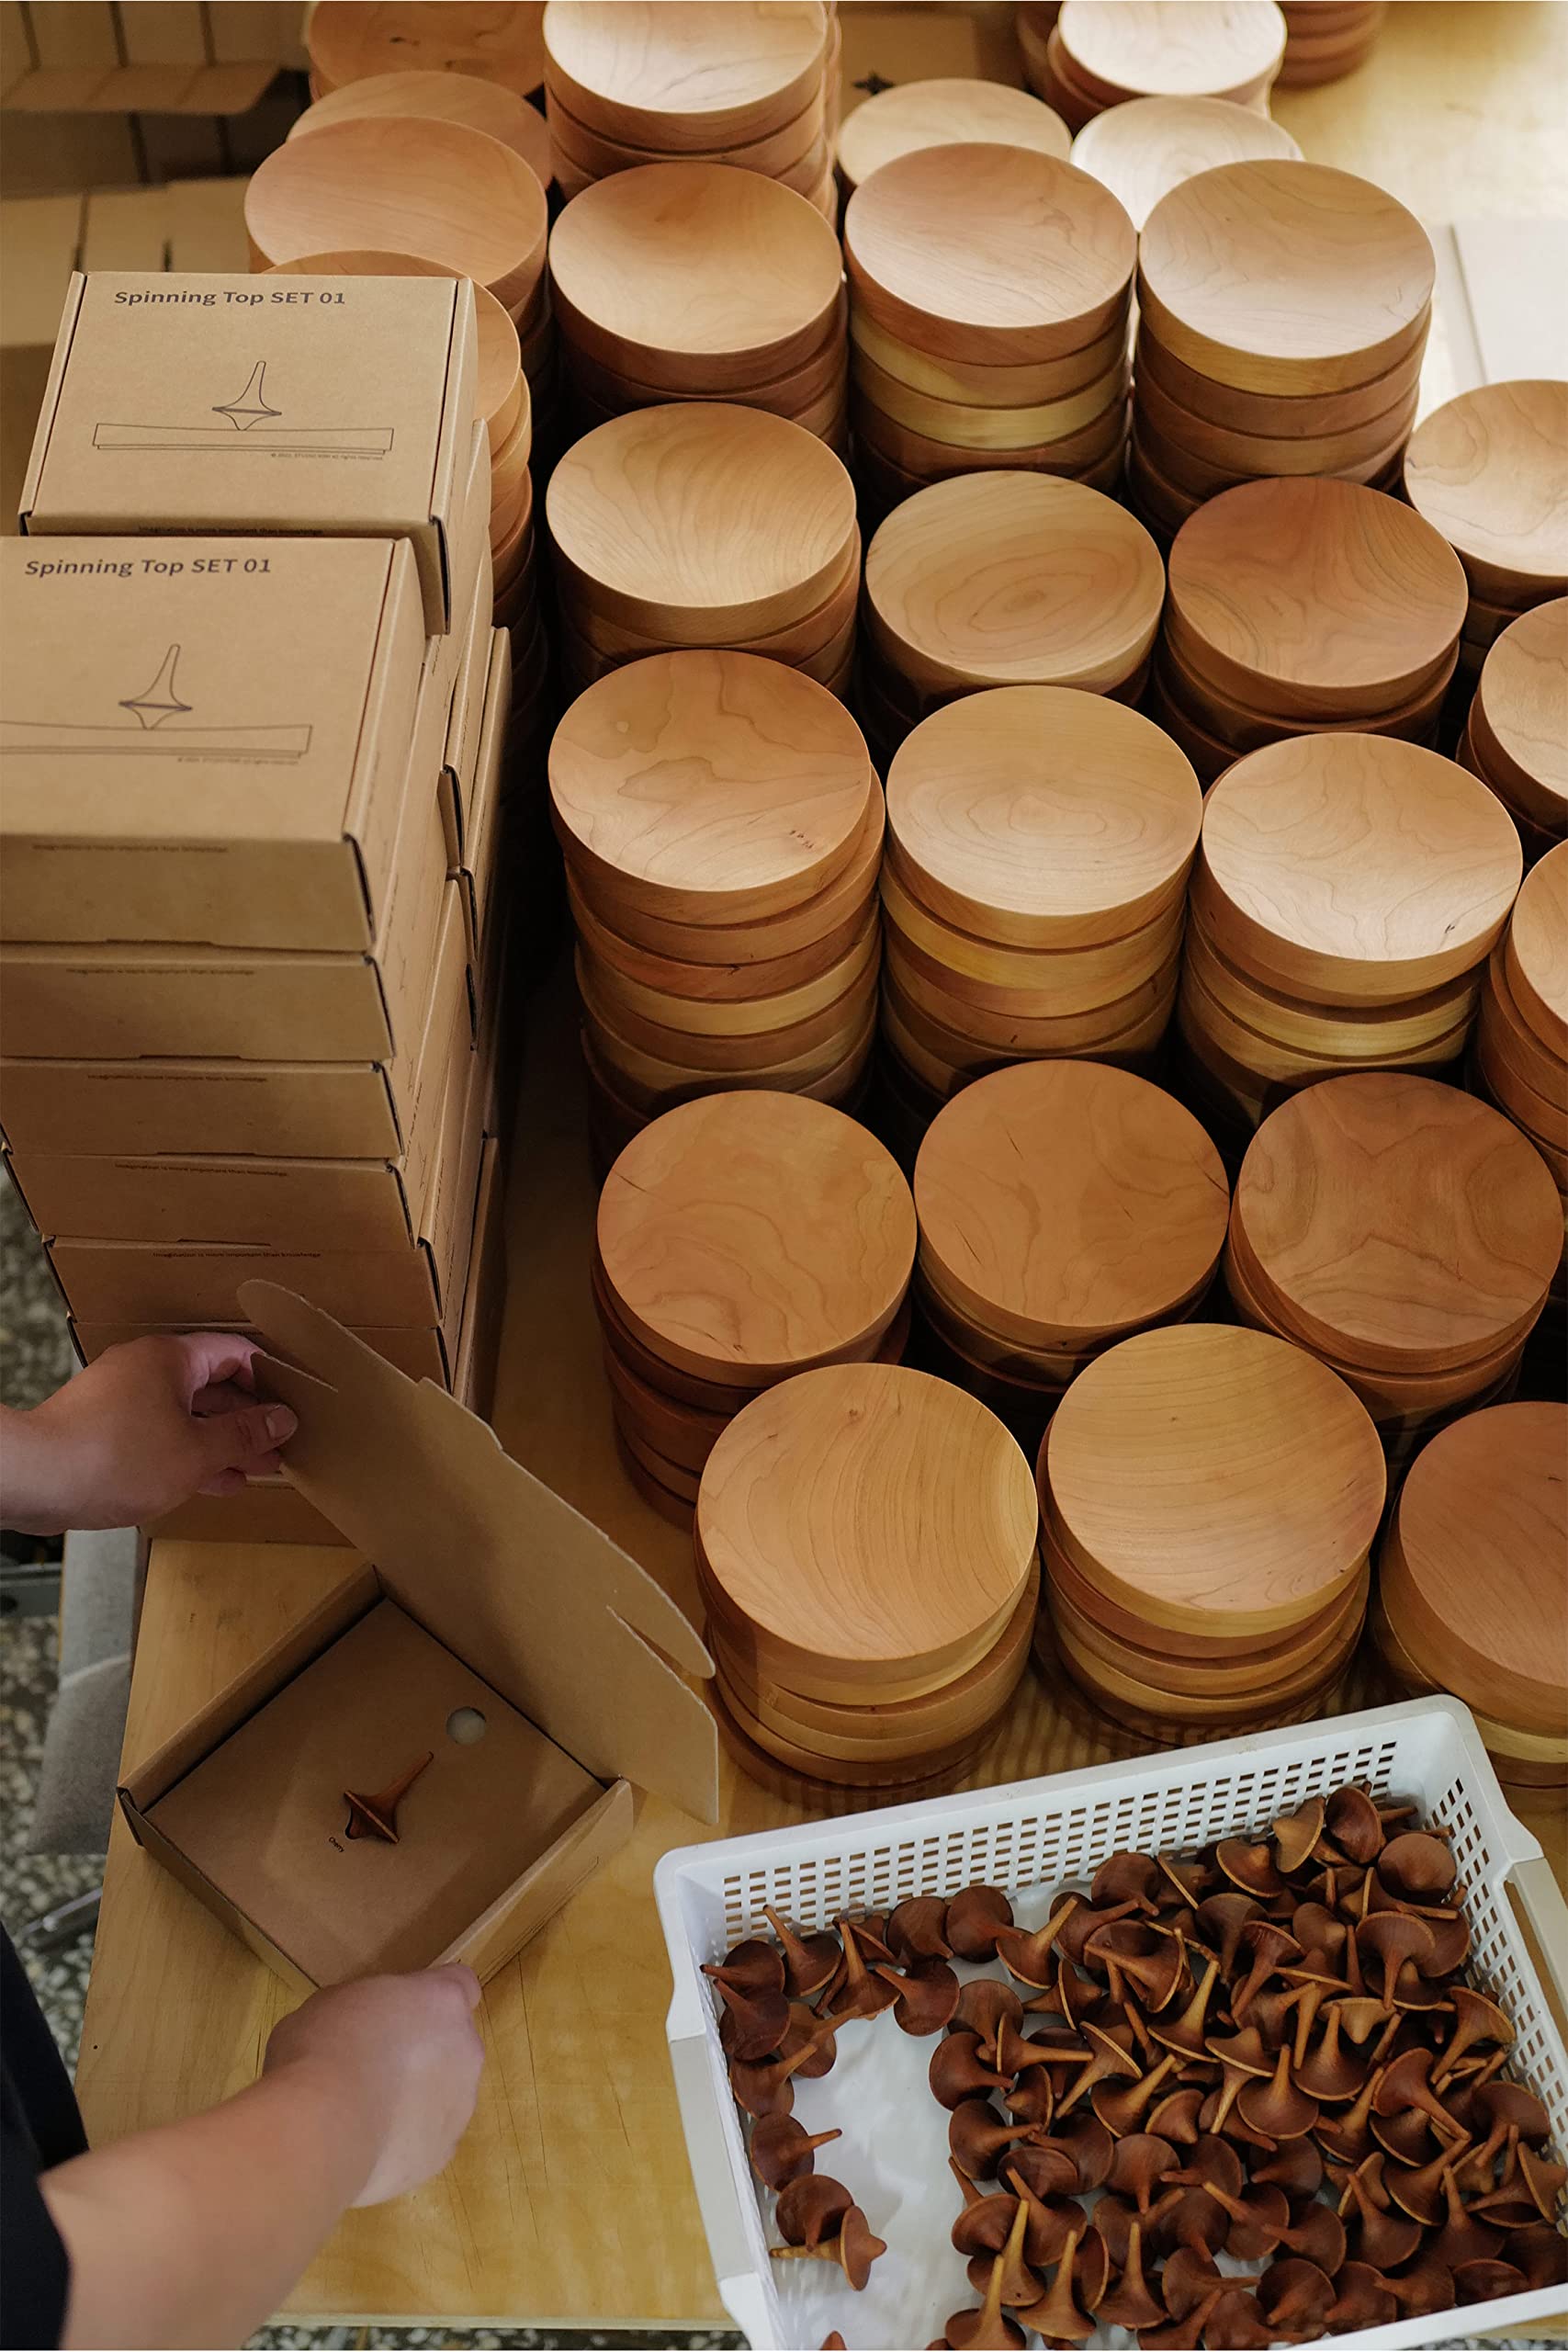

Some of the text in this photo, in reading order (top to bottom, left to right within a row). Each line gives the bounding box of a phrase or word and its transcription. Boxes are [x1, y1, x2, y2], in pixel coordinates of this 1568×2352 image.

[115, 290, 346, 307] Spinning Top SET 01
[25, 559, 271, 578] Spinning Top SET 01
